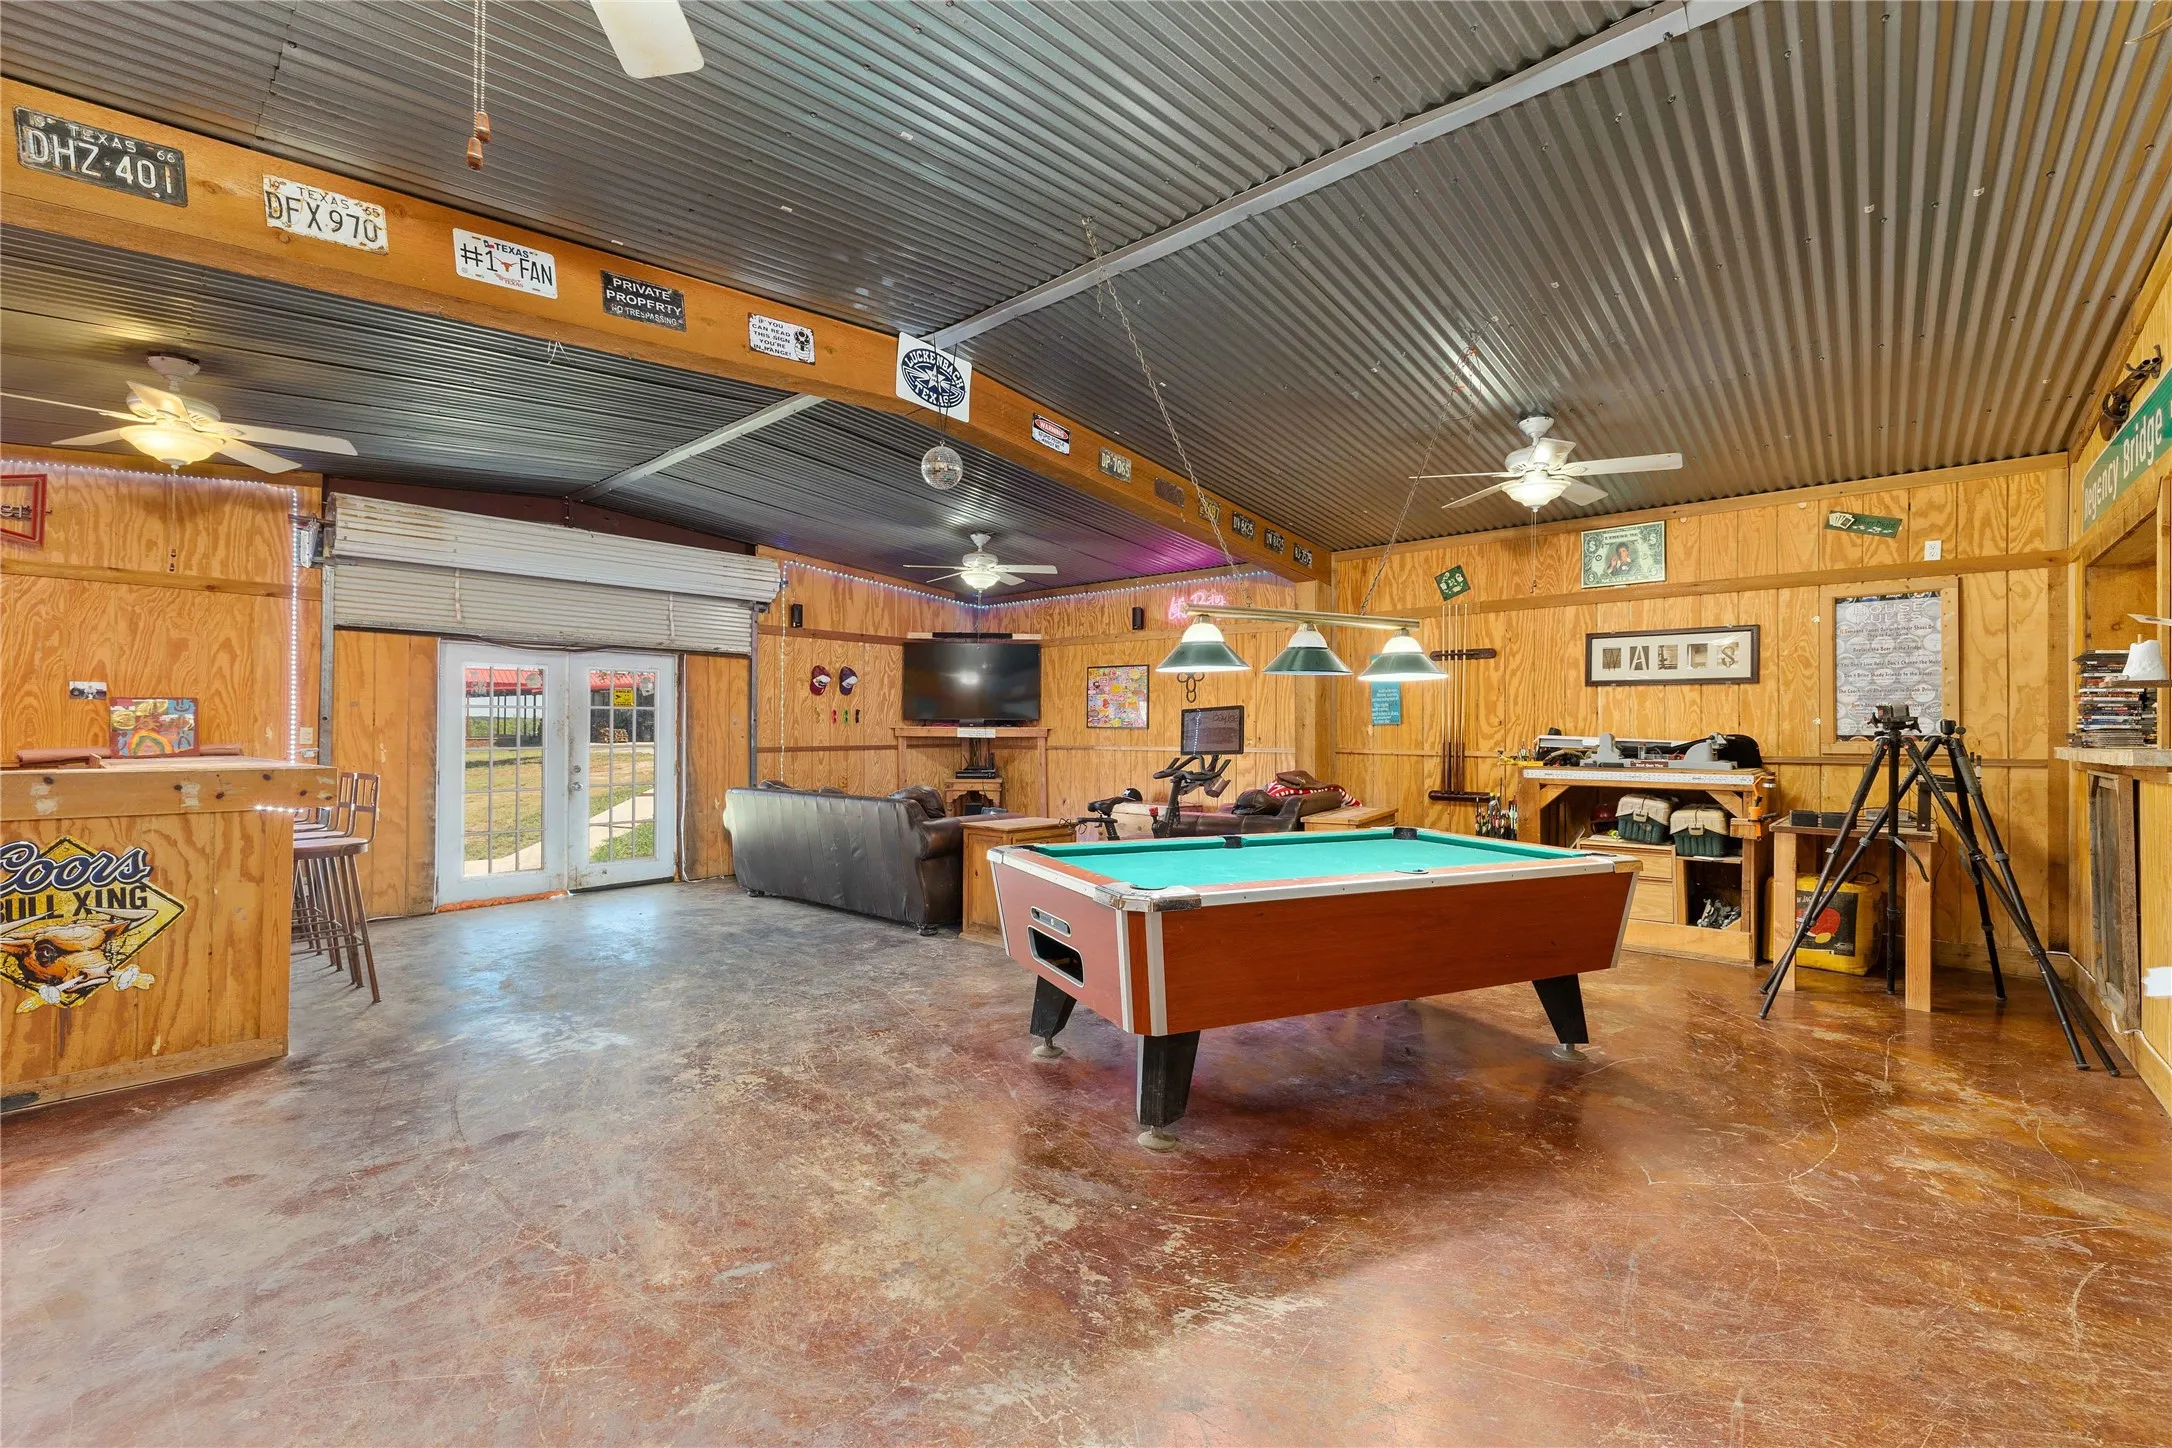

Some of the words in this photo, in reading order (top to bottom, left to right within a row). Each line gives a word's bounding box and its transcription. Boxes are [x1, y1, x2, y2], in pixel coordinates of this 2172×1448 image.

[67, 124, 137, 153] TEXAS
[156, 150, 176, 163] 66
[297, 186, 350, 210] TEXAS
[363, 206, 381, 219] 65
[494, 242, 530, 258] TEXAS
[460, 243, 498, 272] #1
[519, 257, 553, 287] FAN
[612, 278, 671, 301] PRIVATE
[606, 289, 682, 316] PROPERTY
[611, 303, 624, 314] NO
[625, 307, 677, 326] TRESPASSING
[768, 321, 784, 329] YOU
[751, 323, 769, 332] CAN
[771, 328, 791, 337] READ
[753, 330, 770, 339] THIS
[773, 336, 790, 344] SIGN
[759, 338, 786, 349] YOU'RE
[763, 346, 792, 357] RANGE!
[904, 350, 964, 388] LUCKENBACH
[914, 381, 951, 407] TEXAS
[1039, 421, 1064, 439] WARNING
[2084, 455, 2119, 521] Regency
[2123, 408, 2163, 479] Bridge
[1854, 601, 1924, 615] HOUSE
[1855, 611, 1922, 624] RULES
[1603, 642, 1739, 671] WALLS
[0, 840, 153, 897] Coors
[72, 885, 149, 917] XING
